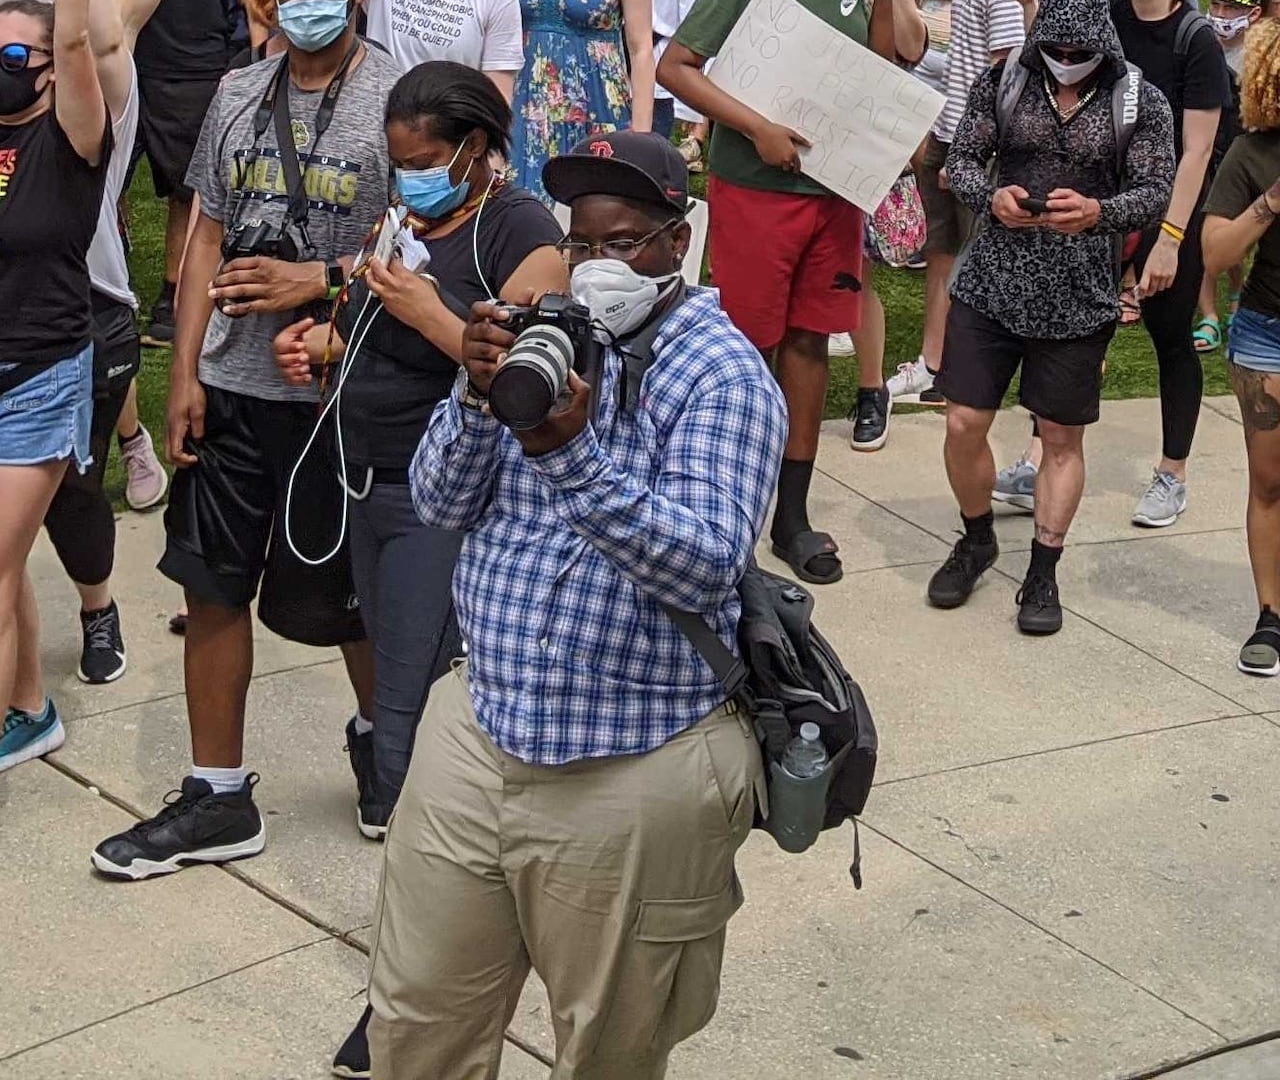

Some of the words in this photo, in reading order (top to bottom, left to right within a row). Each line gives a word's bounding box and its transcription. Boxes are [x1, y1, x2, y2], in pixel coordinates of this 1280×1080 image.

[408, 29, 421, 39] BE
[421, 33, 454, 49] QUIET?
[412, 17, 431, 29] YOU
[431, 22, 462, 38] COULD
[720, 47, 759, 90] NO
[738, 16, 781, 59] NO
[816, 72, 907, 141] PEACE
[1123, 71, 1140, 125] Wilson
